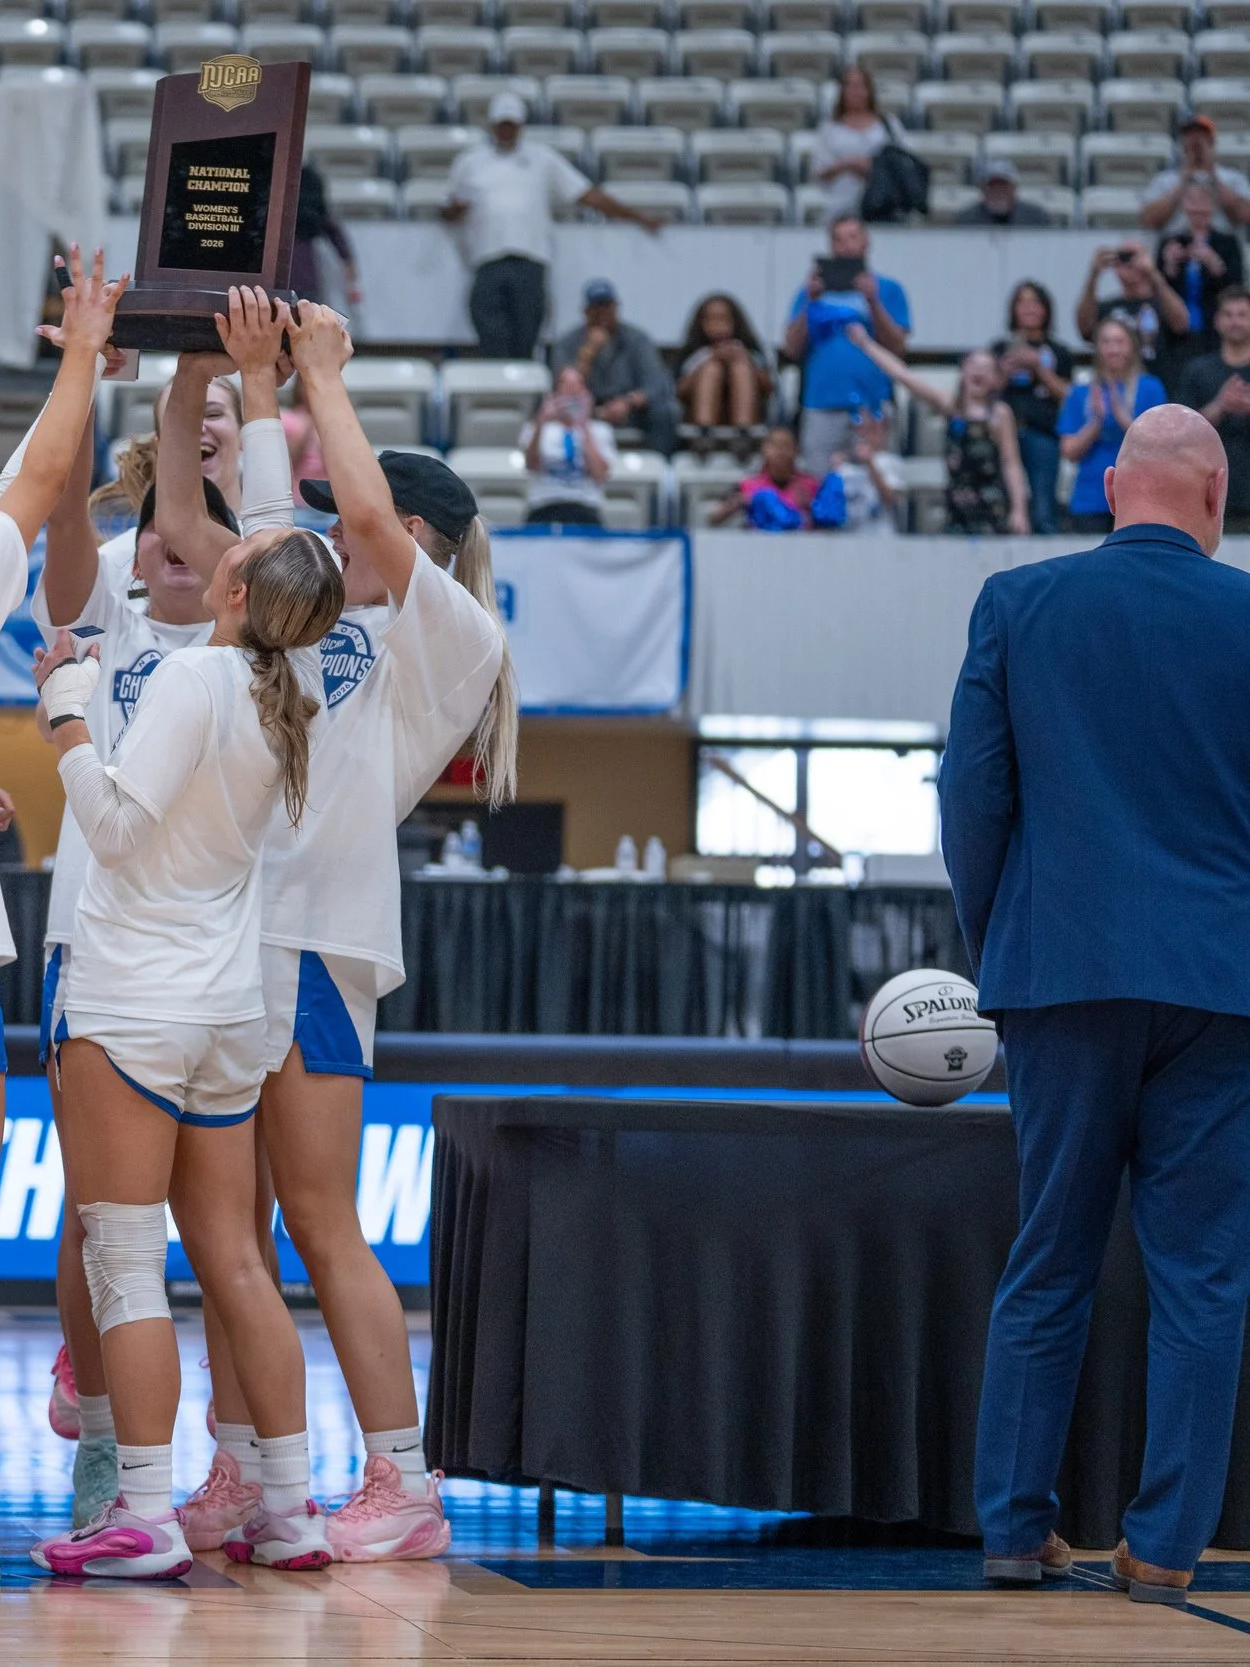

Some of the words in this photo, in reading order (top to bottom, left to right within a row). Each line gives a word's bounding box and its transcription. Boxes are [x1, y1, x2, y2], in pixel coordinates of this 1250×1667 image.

[201, 64, 259, 90] NJCAA
[189, 166, 250, 178] NATIONAL
[187, 180, 250, 192] CHAMPION
[193, 204, 238, 214] WOMEN'S
[185, 213, 244, 223] BASKETBALL
[188, 222, 229, 231] DIVISION
[230, 224, 239, 232] III
[200, 239, 224, 248] 2026
[331, 683, 351, 700] 2026
[903, 996, 977, 1024] SPALDIN
